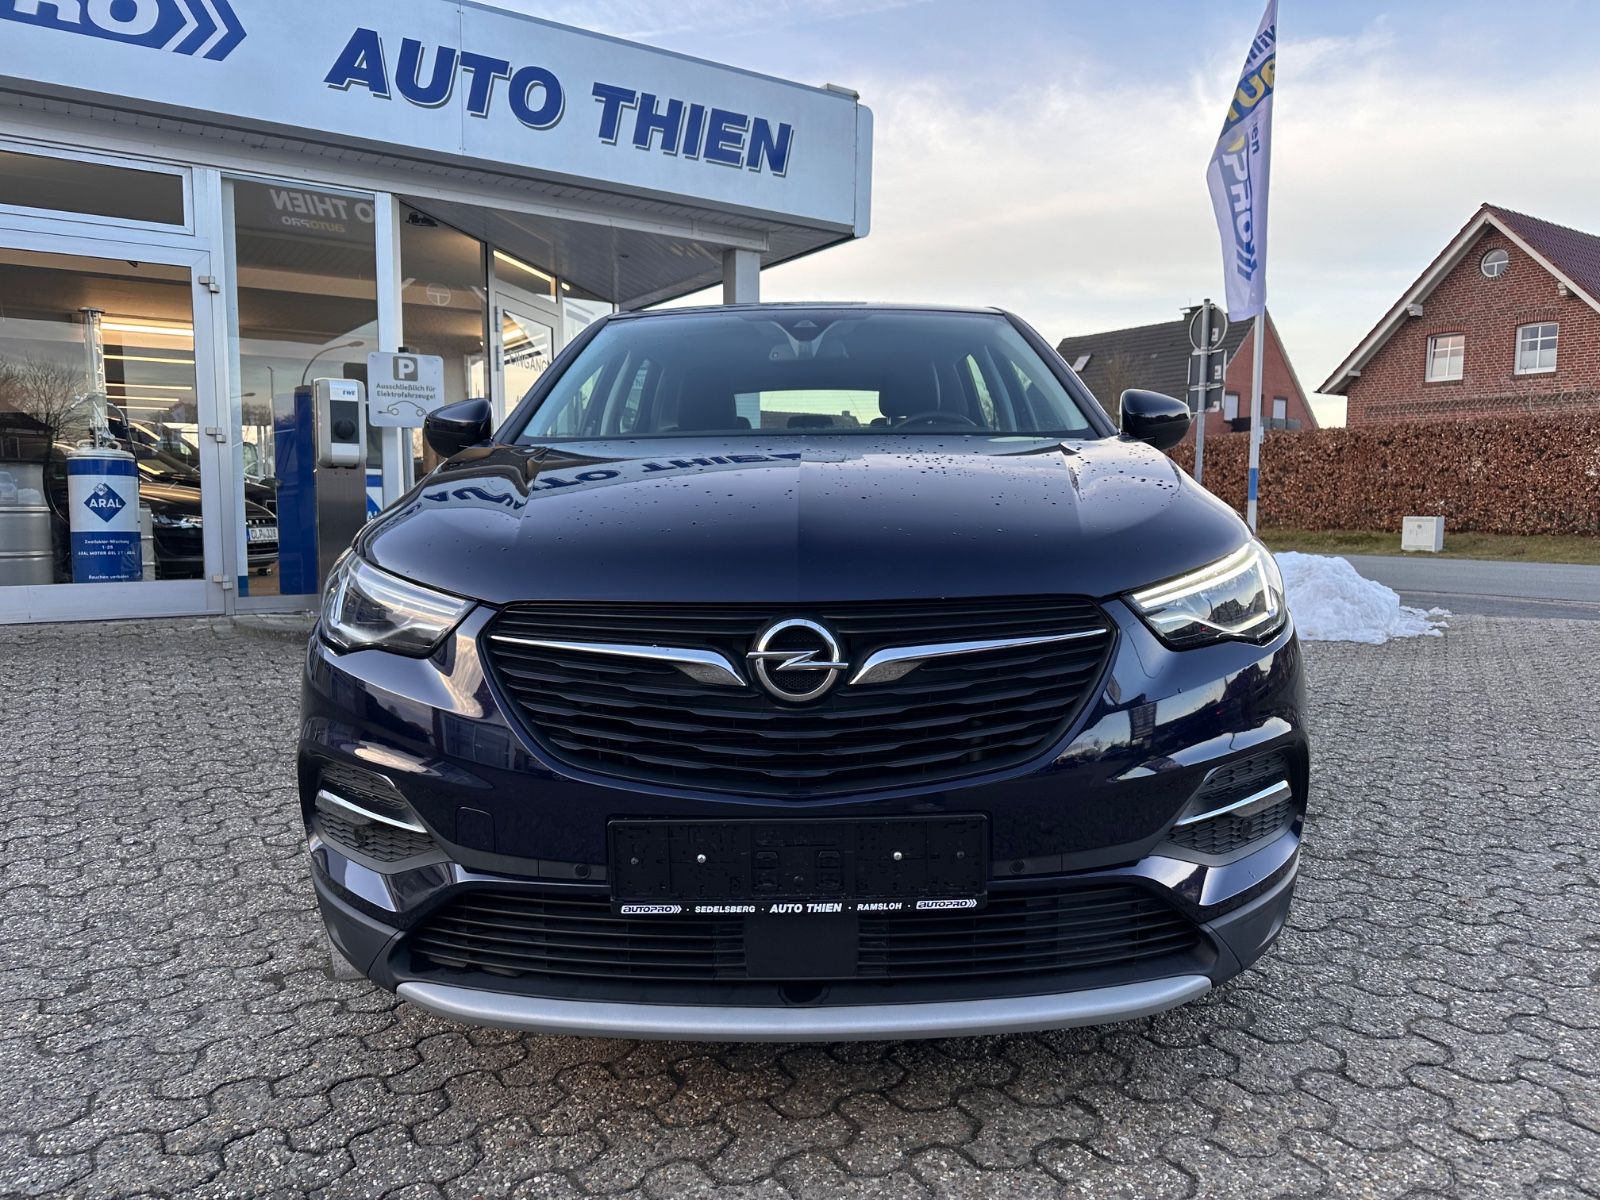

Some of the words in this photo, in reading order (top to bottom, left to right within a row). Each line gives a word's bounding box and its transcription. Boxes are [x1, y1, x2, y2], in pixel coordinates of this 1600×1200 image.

[324, 27, 566, 130] AUTO
[591, 82, 794, 177] THIEN
[89, 499, 122, 508] ARAL
[695, 905, 756, 913] SEDELSBERG
[769, 904, 803, 914] AUTO
[806, 903, 843, 913] THIEN
[857, 903, 903, 911] RAMSLOH
